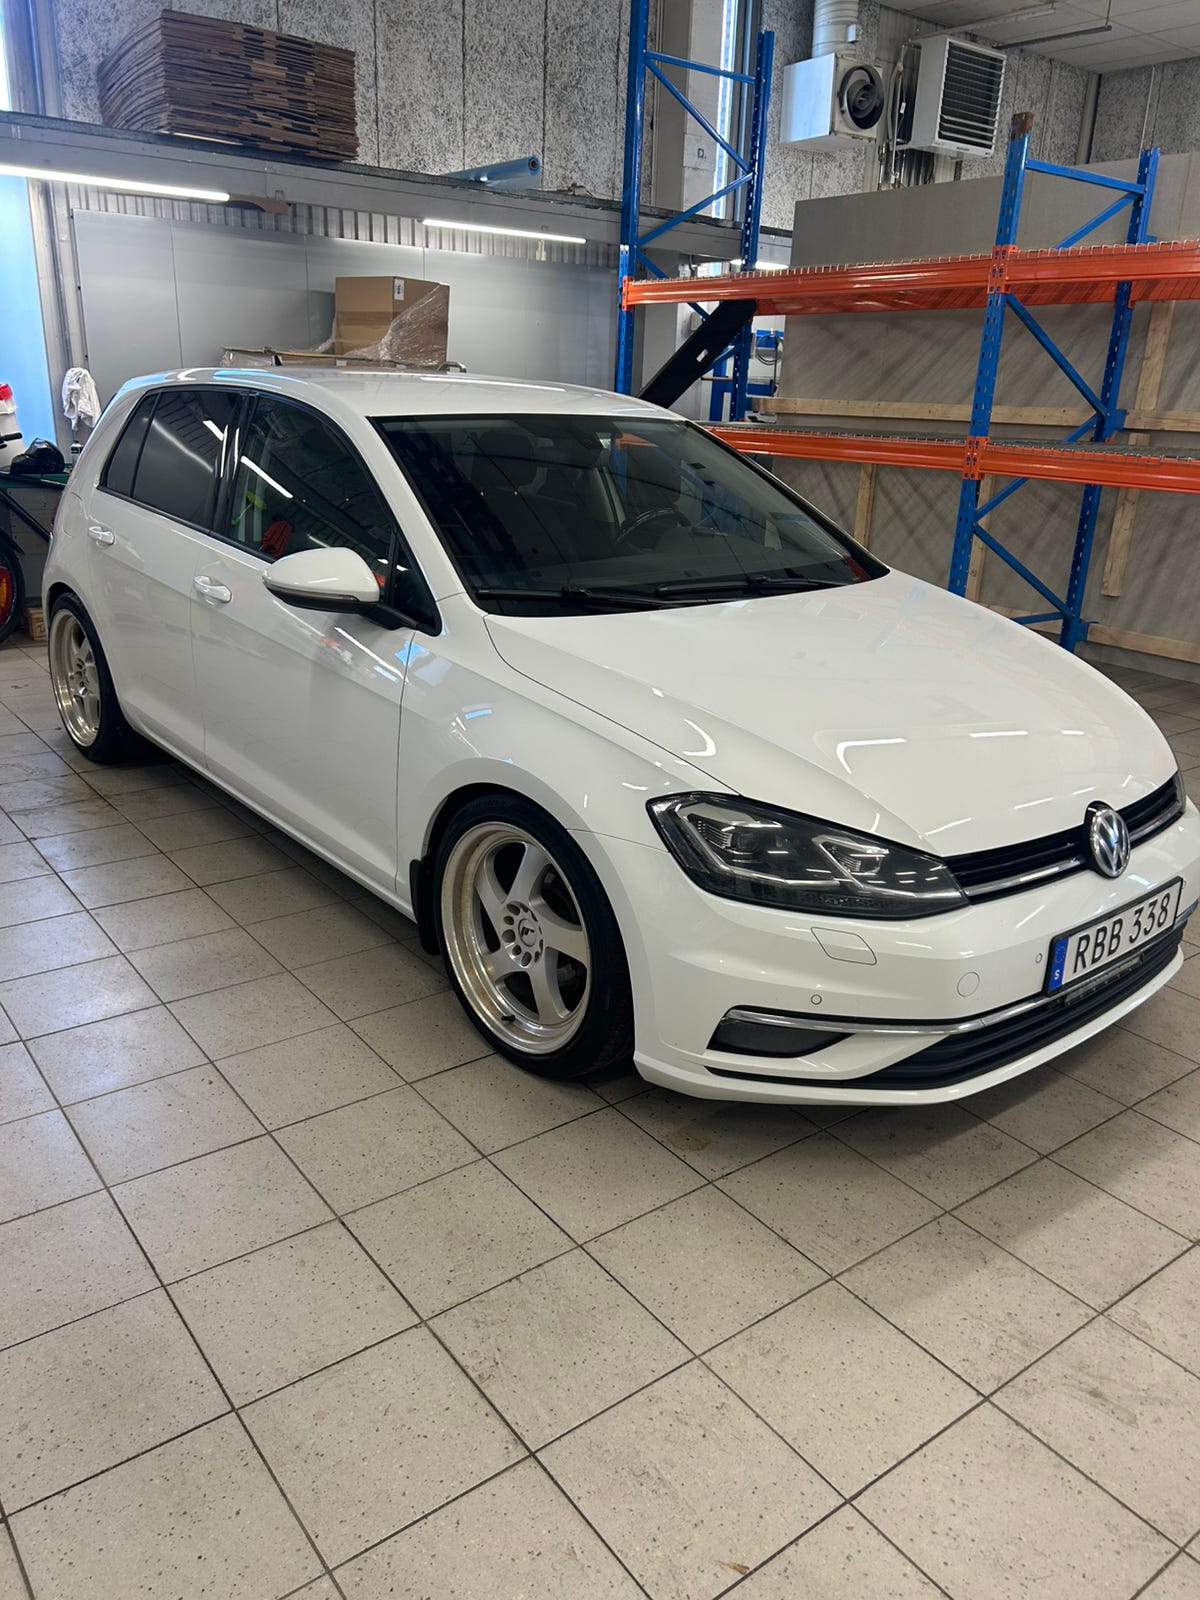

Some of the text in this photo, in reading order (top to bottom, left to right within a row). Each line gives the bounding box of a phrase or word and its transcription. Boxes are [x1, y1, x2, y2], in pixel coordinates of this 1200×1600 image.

[1073, 892, 1171, 973] RBB 338
[1053, 969, 1060, 980] S
